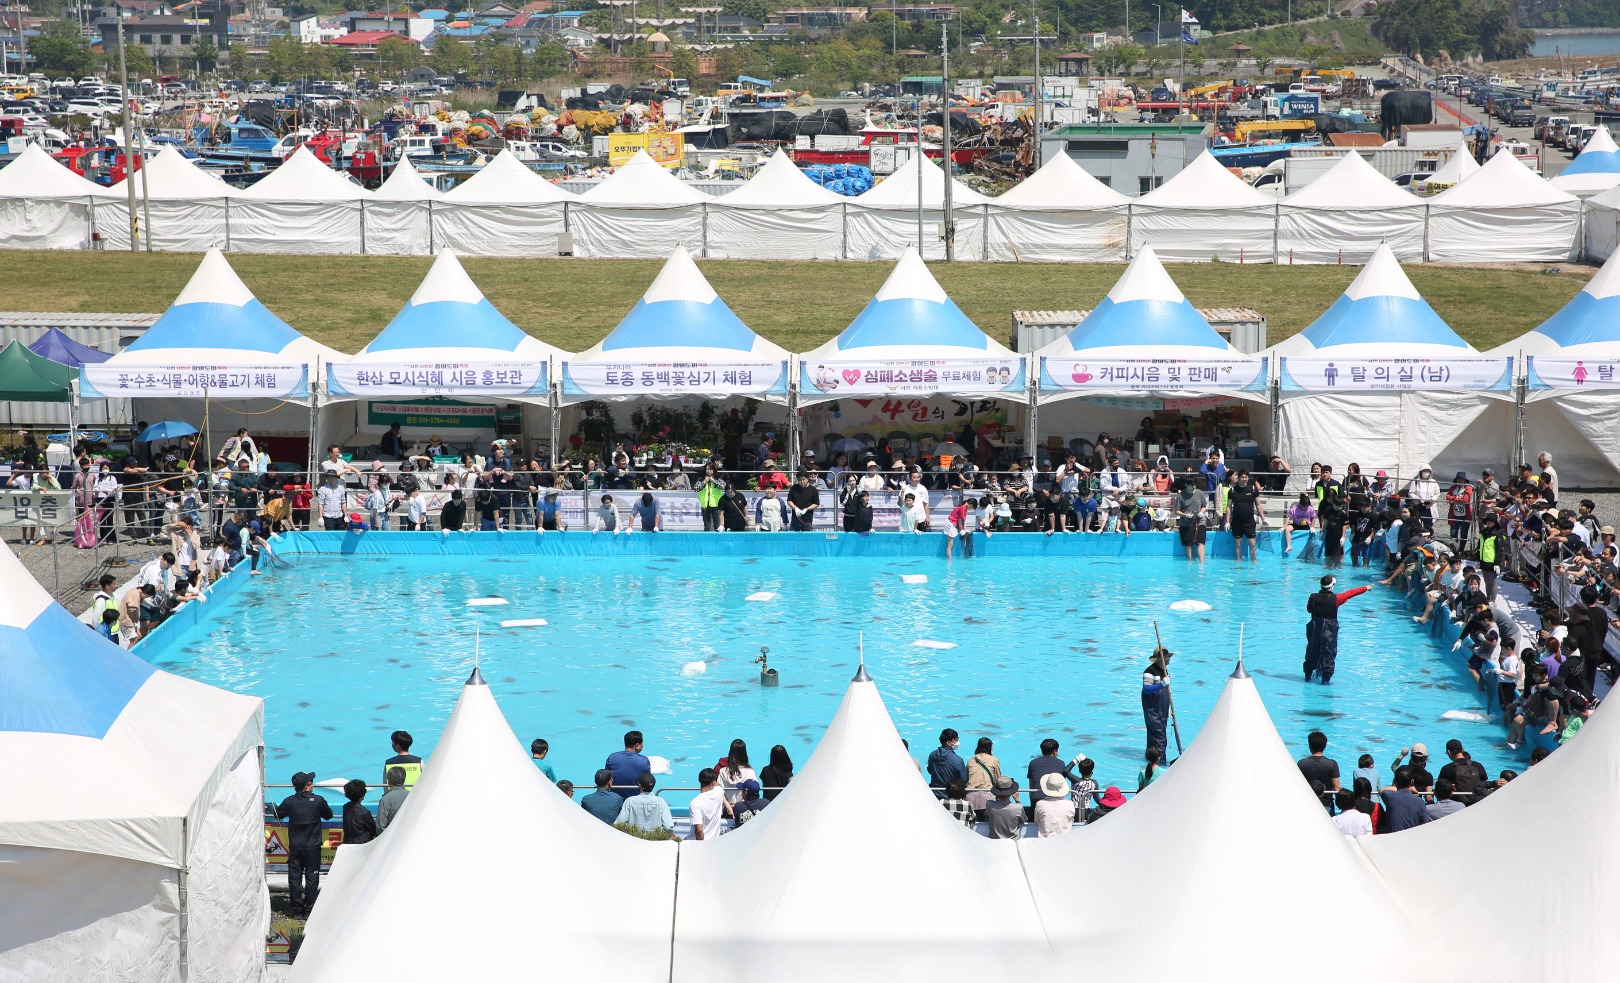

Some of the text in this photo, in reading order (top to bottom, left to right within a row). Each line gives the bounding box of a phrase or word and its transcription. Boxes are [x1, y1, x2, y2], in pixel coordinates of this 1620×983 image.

[254, 373, 276, 389] 체험
[356, 370, 523, 386] 한산 모시식혜 시음 홍보관
[605, 370, 752, 387] 토종 동백꽃심기 체험
[864, 369, 981, 384] 심폐소생술 무료체험
[1100, 366, 1218, 382] 커피시음 및 판매
